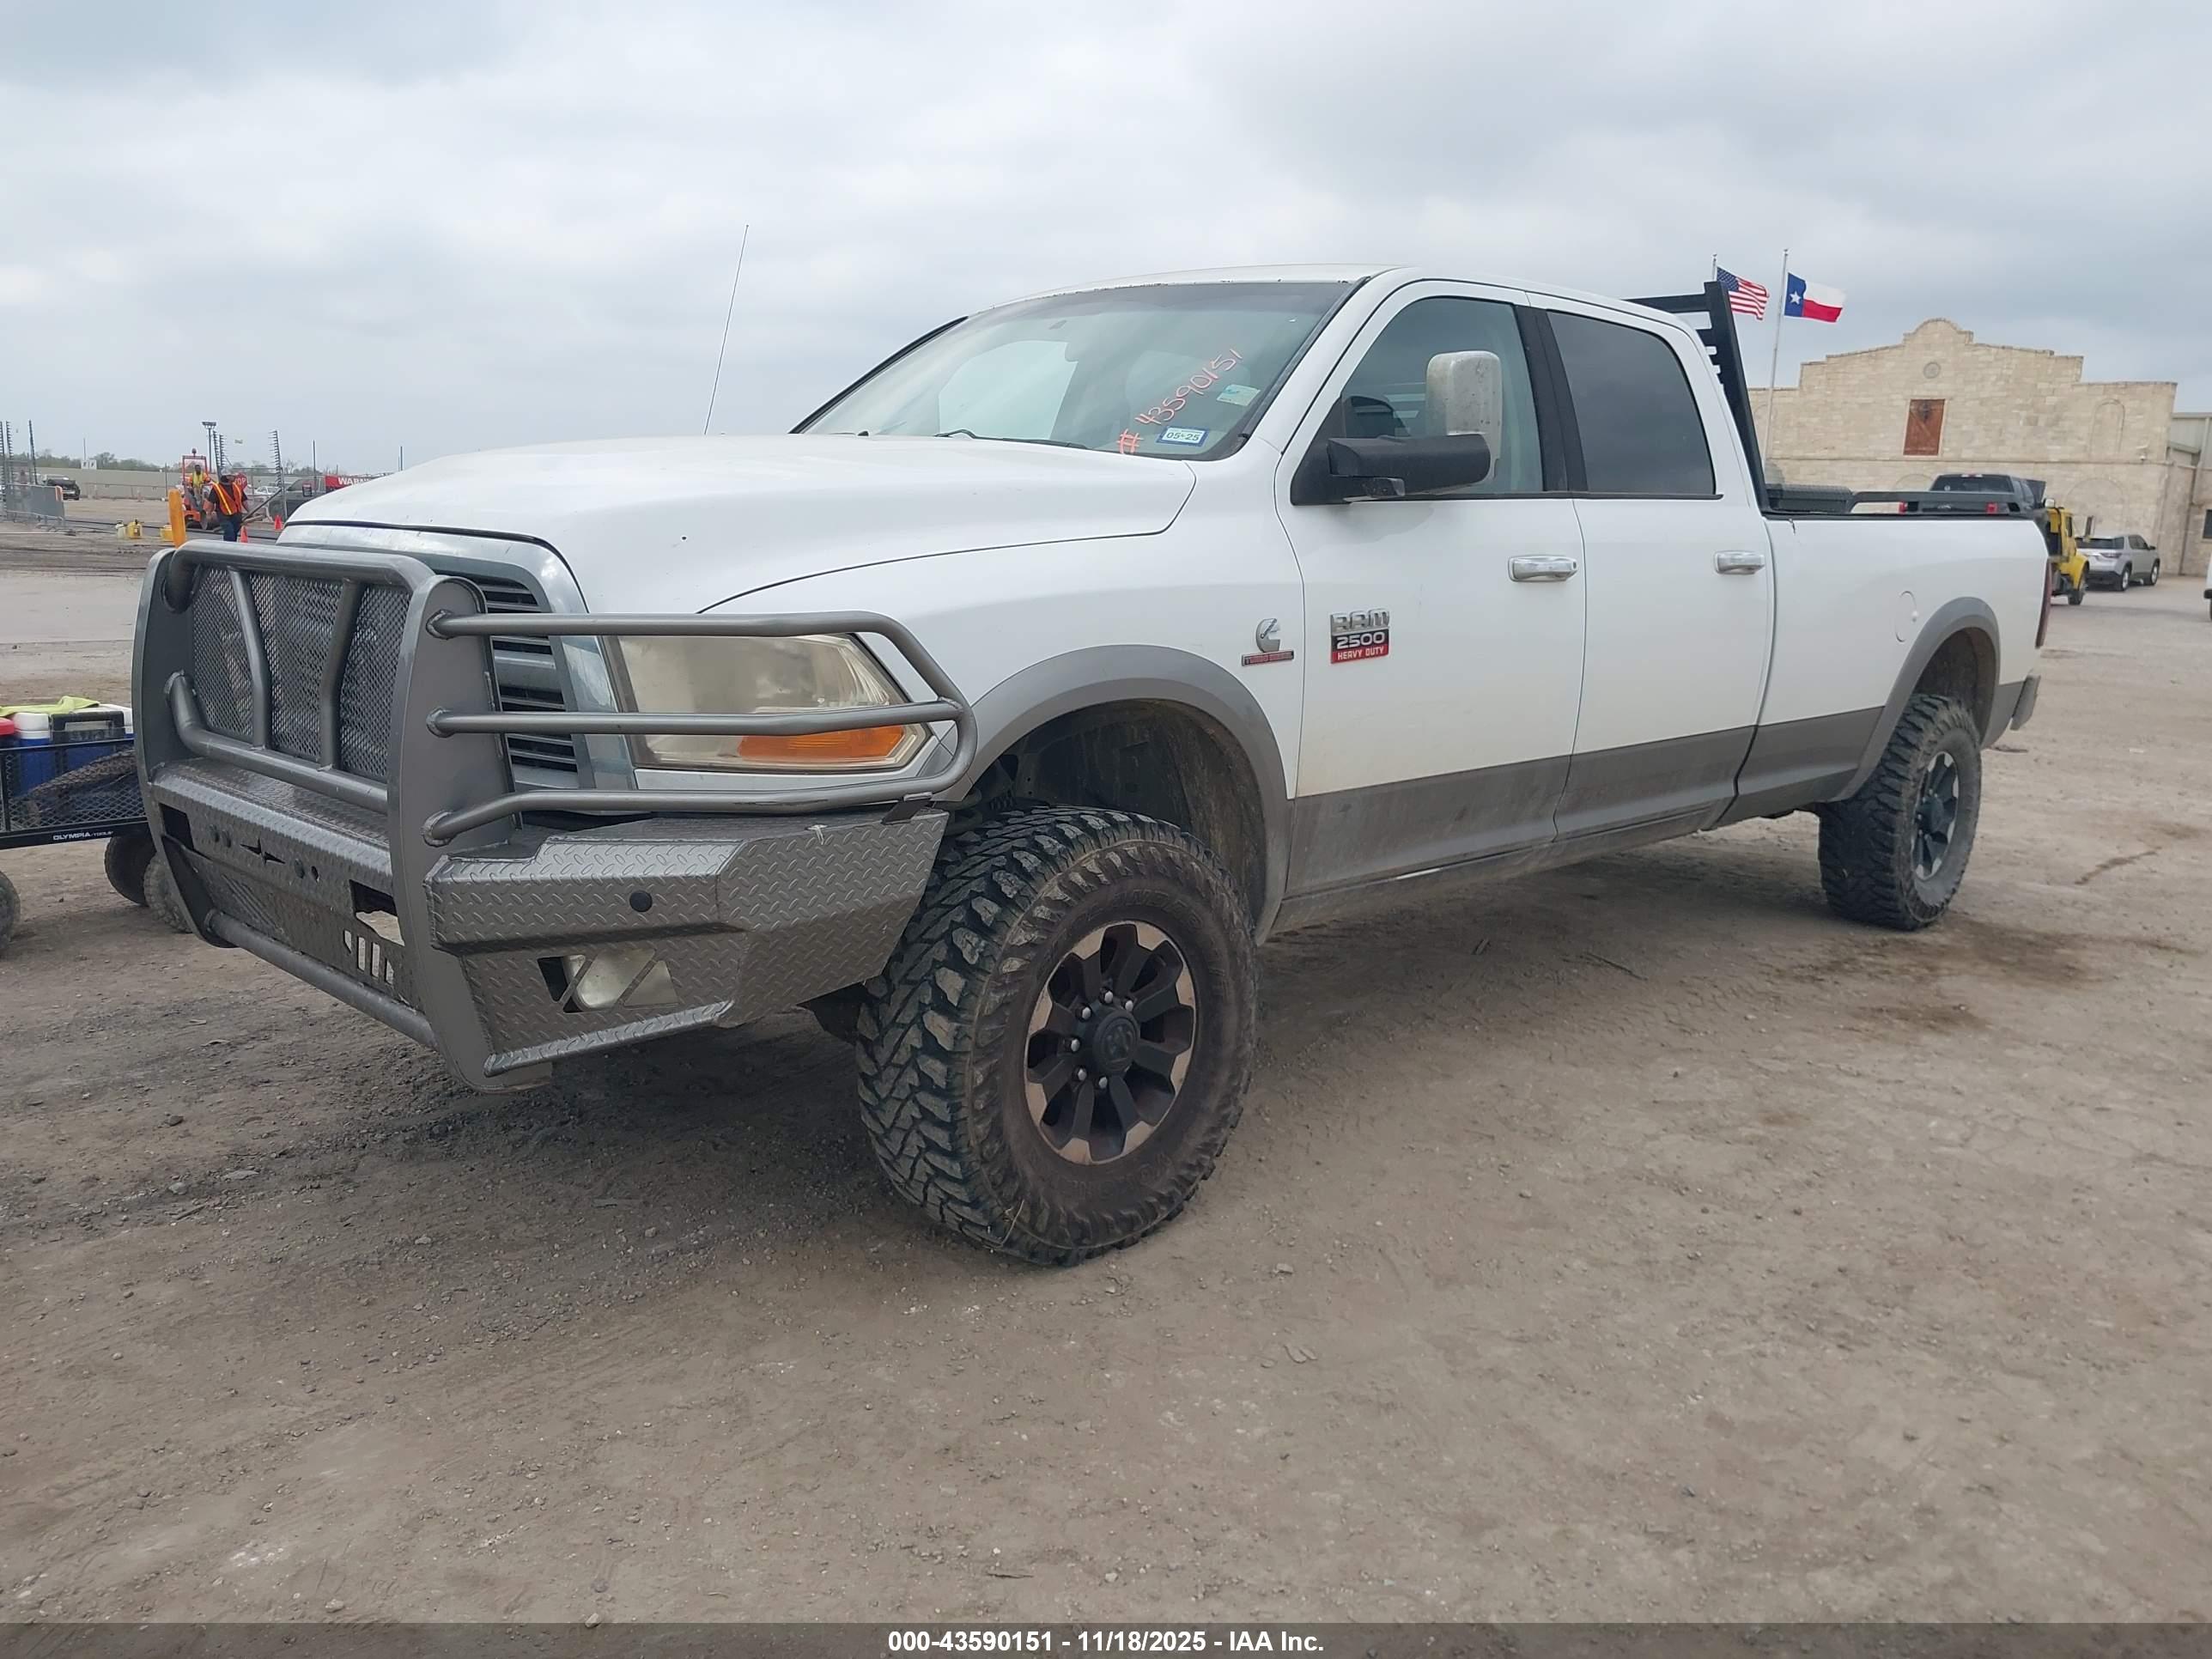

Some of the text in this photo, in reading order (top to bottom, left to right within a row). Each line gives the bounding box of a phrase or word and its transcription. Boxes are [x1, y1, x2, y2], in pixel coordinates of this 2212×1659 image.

[1331, 608, 1389, 633] RAM
[1336, 632, 1385, 650] 2500
[1337, 646, 1384, 661] HEAVY DUTY
[52, 831, 91, 841] OLYMPIA
